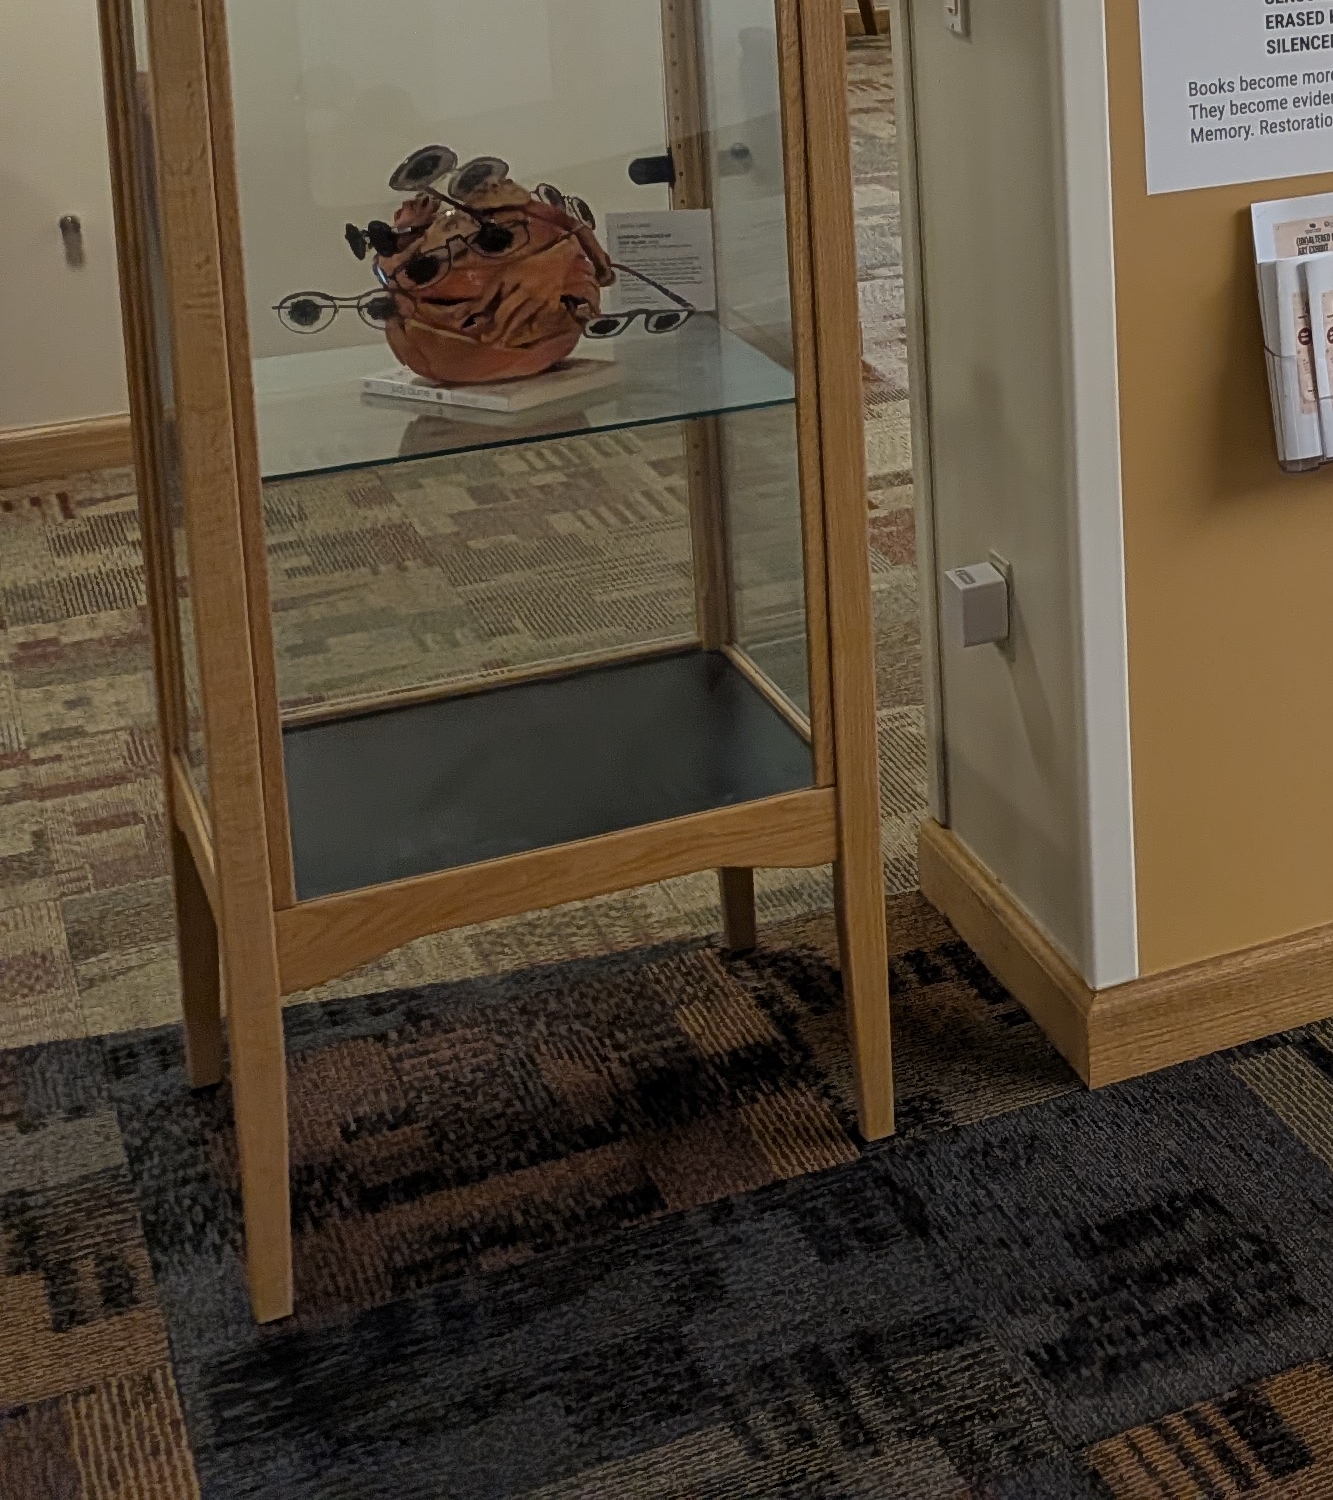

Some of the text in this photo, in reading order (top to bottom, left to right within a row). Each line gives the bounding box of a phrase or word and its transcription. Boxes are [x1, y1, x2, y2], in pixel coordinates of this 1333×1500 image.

[1265, 11, 1325, 30] ERASED
[1188, 78, 1235, 97] Books
[1239, 74, 1298, 93] become
[1189, 101, 1225, 123] They
[1229, 96, 1288, 116] become
[1190, 123, 1255, 145] Memory.
